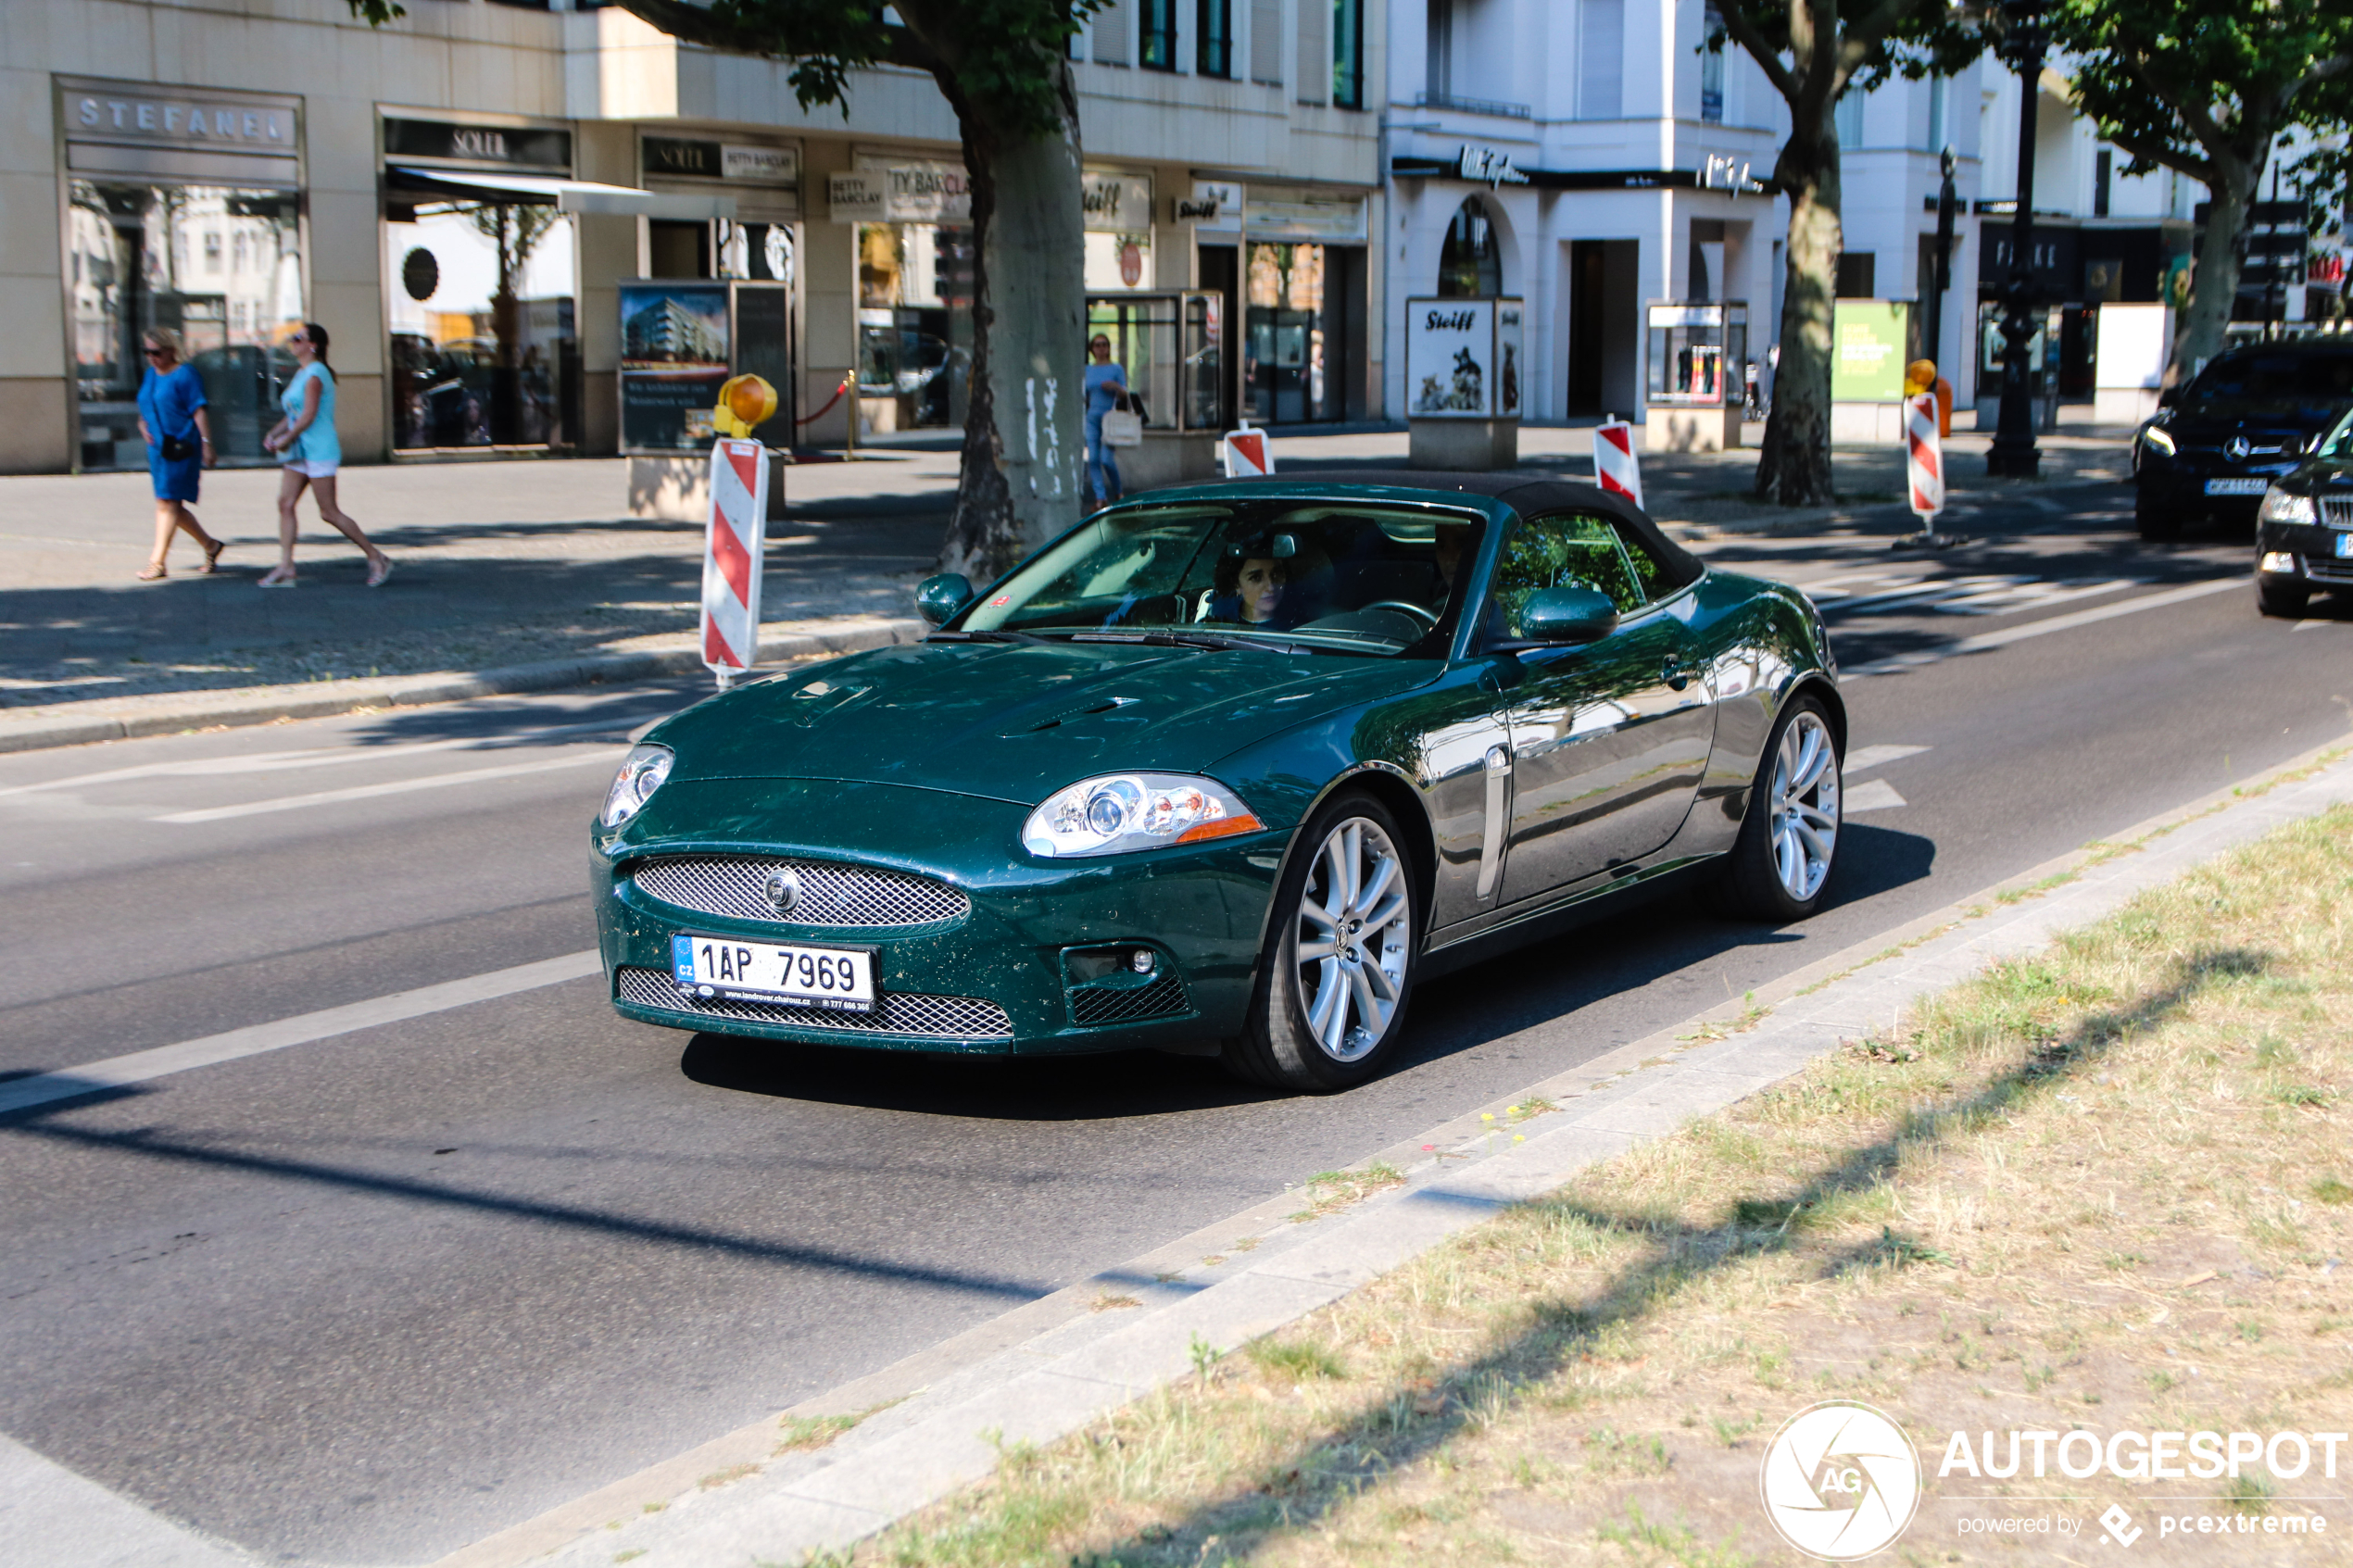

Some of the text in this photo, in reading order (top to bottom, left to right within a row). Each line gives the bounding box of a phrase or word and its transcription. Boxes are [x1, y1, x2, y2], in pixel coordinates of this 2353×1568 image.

[80, 97, 282, 138] STEFANEL
[834, 180, 865, 191] BETTY
[833, 194, 880, 204] BARCLAY
[1426, 308, 1476, 332] Steiff
[679, 965, 694, 976] CZ
[701, 944, 855, 992] 1AP 7969
[725, 990, 811, 1005] www.landrover.charouz.cz
